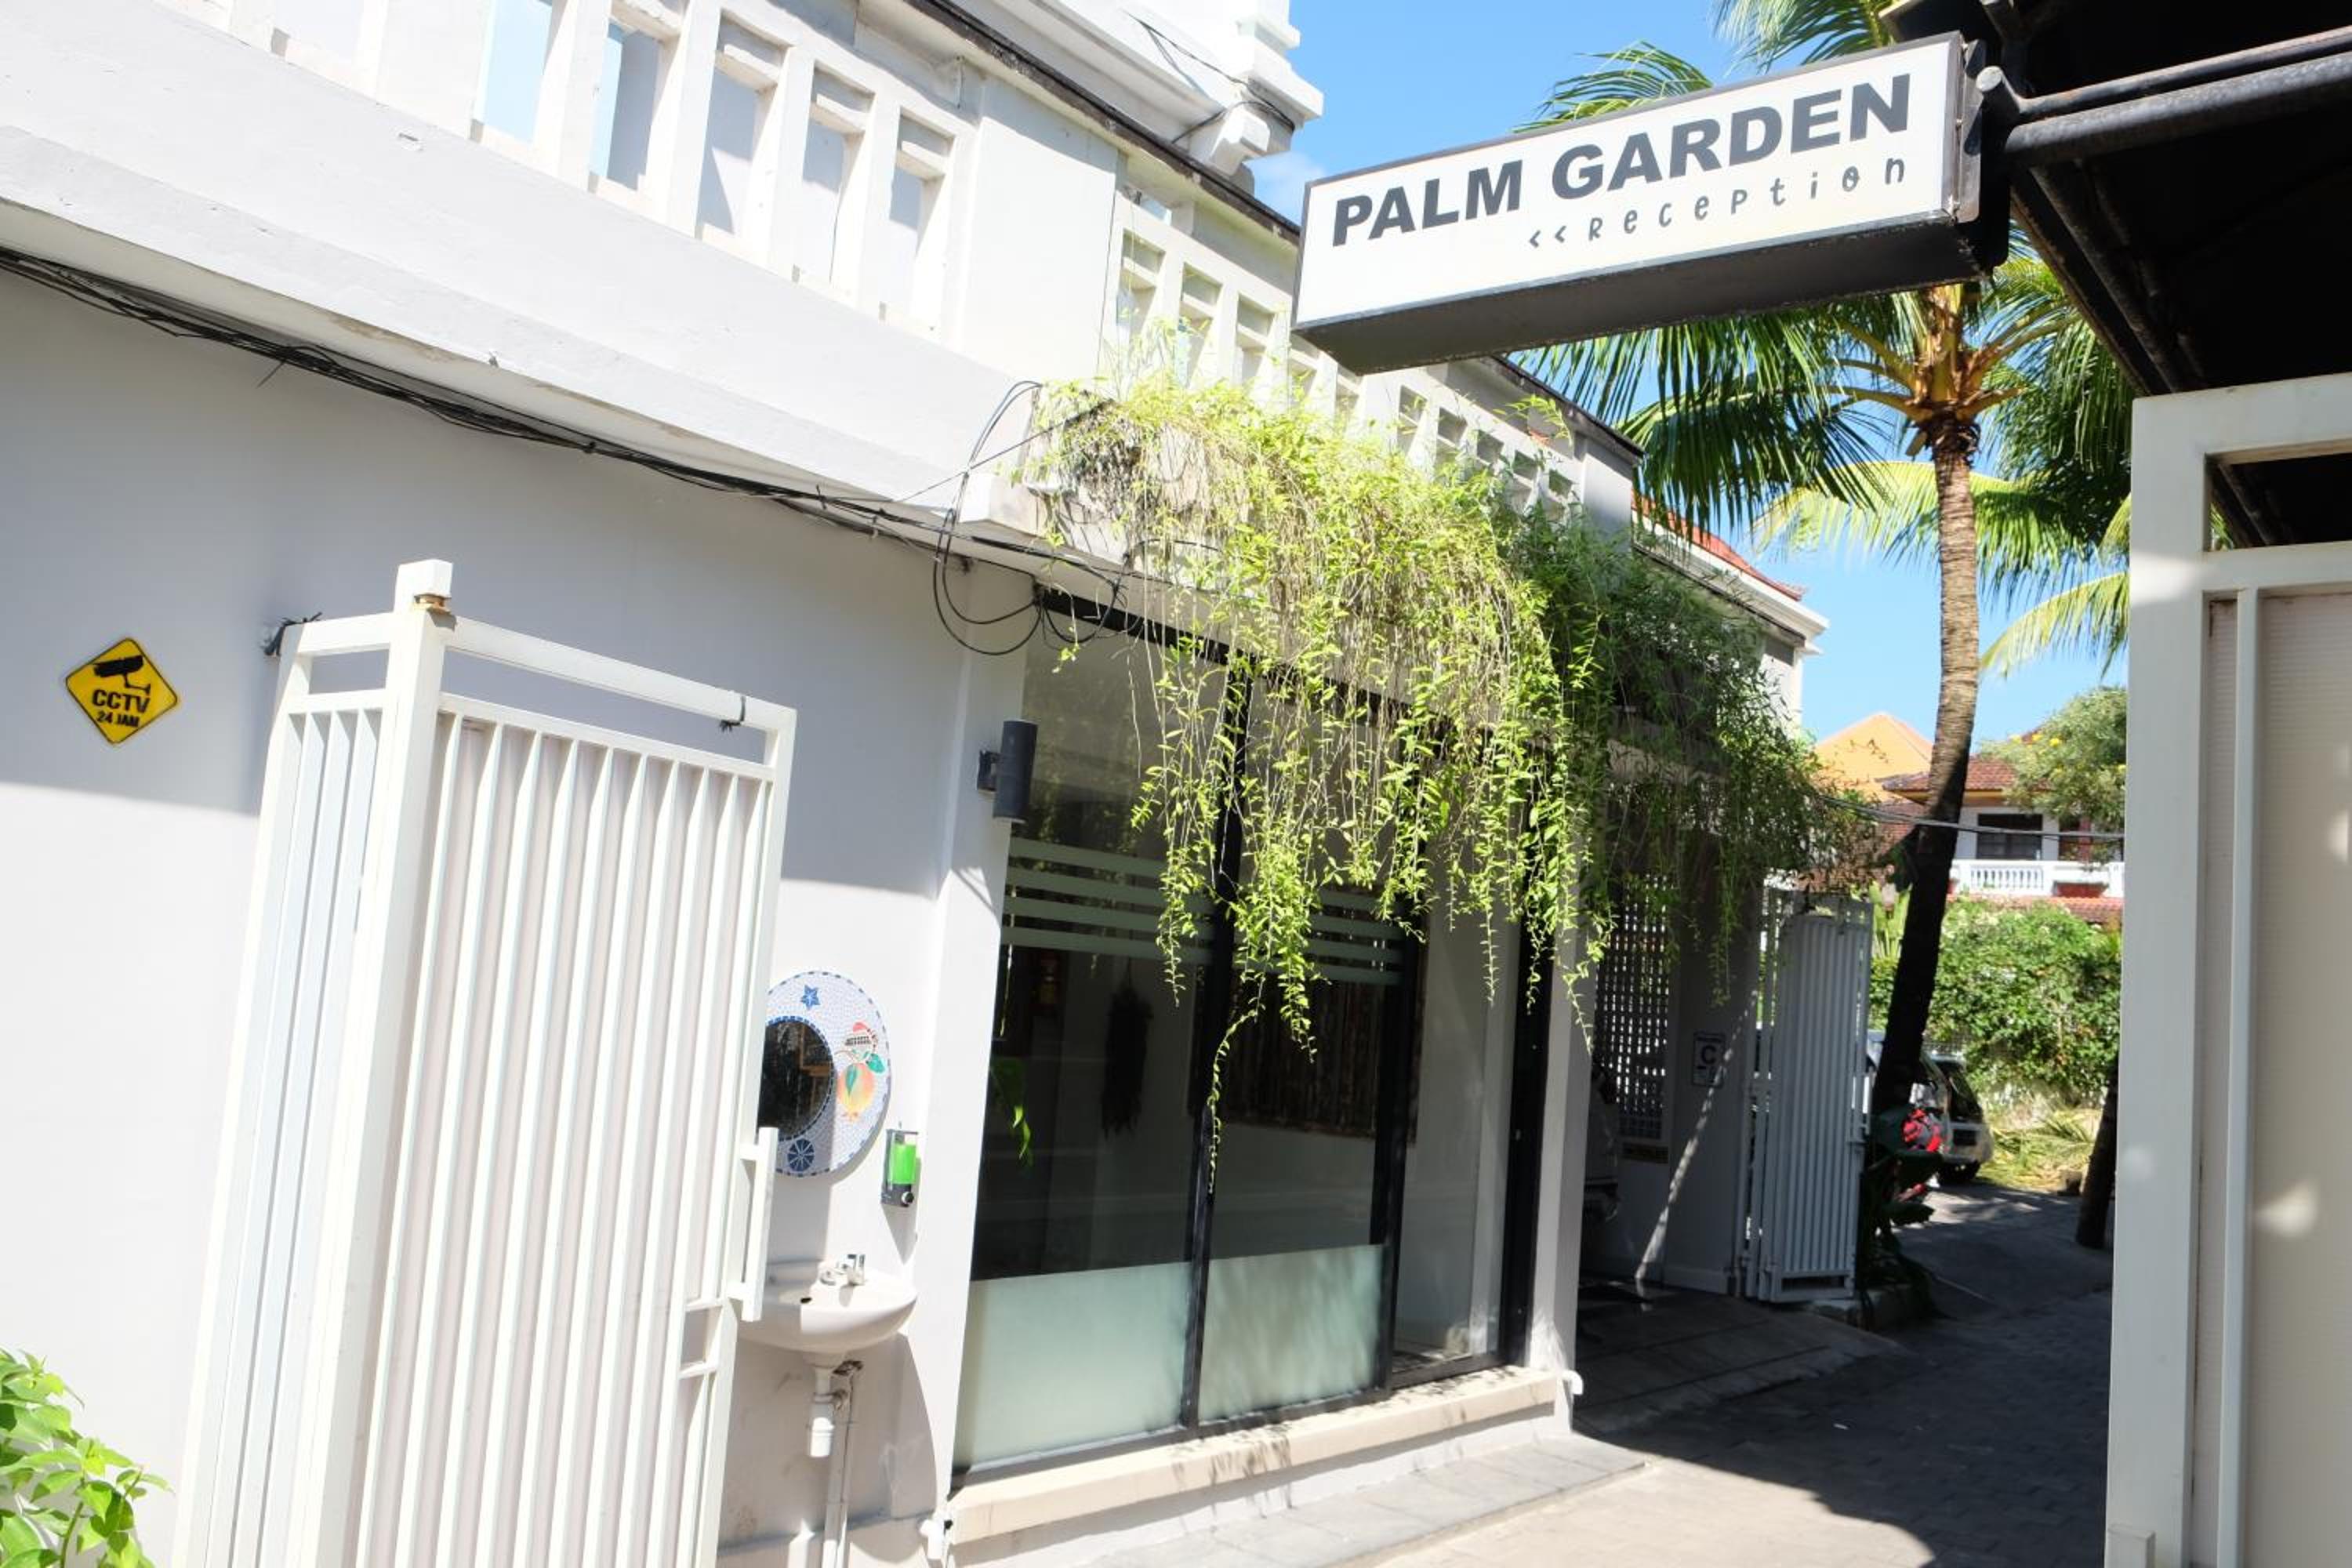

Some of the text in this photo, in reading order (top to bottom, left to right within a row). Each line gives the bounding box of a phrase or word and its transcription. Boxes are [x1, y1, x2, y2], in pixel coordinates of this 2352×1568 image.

[1332, 74, 1911, 247] PALM GARDEN
[92, 688, 151, 713] CCTV
[96, 710, 113, 724] 24
